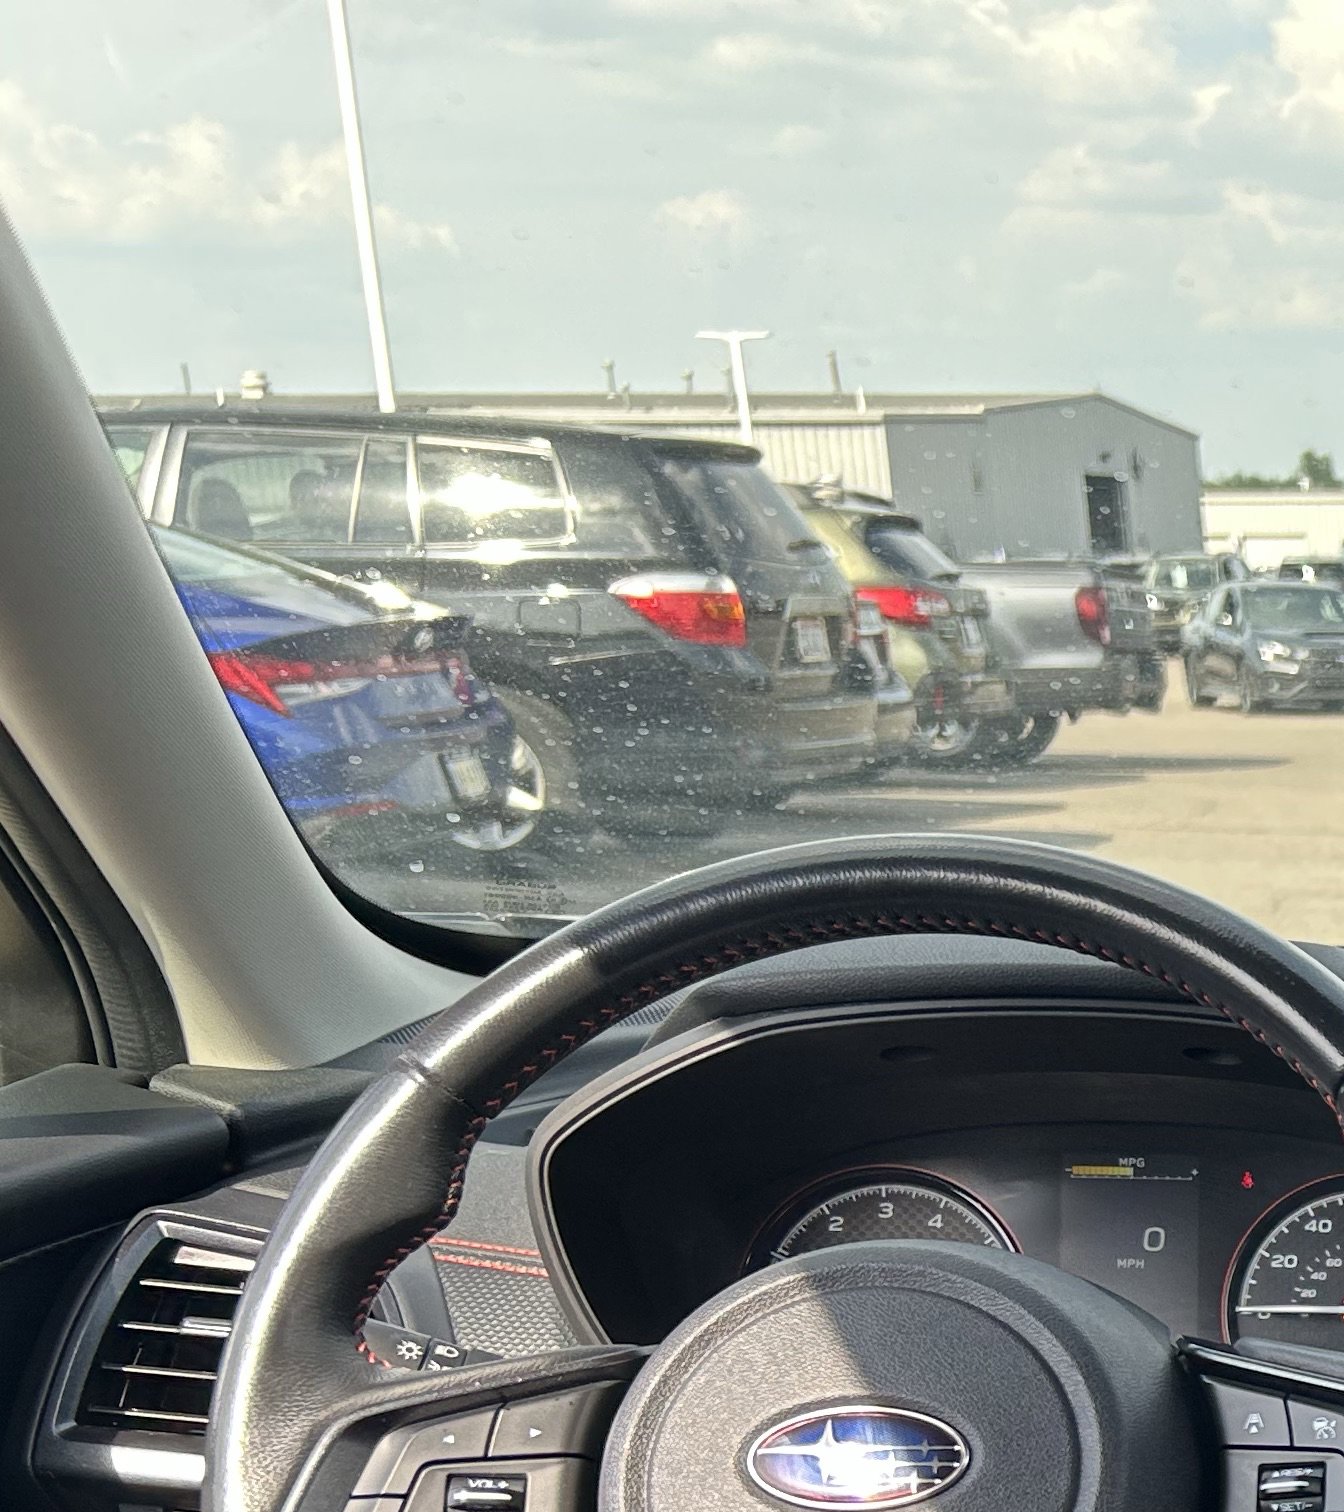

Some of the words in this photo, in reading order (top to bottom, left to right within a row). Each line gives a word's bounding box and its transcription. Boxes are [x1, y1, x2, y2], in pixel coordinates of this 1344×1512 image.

[1119, 1157, 1146, 1168] MPG
[877, 1202, 895, 1220] 3
[828, 1216, 845, 1234] 2
[926, 1212, 945, 1230] 4
[1304, 1219, 1332, 1233] 40
[1142, 1226, 1166, 1252] 0
[1116, 1258, 1146, 1271] MPH
[1270, 1254, 1298, 1269] 20
[1310, 1271, 1328, 1281] 40
[1300, 1289, 1317, 1299] 20
